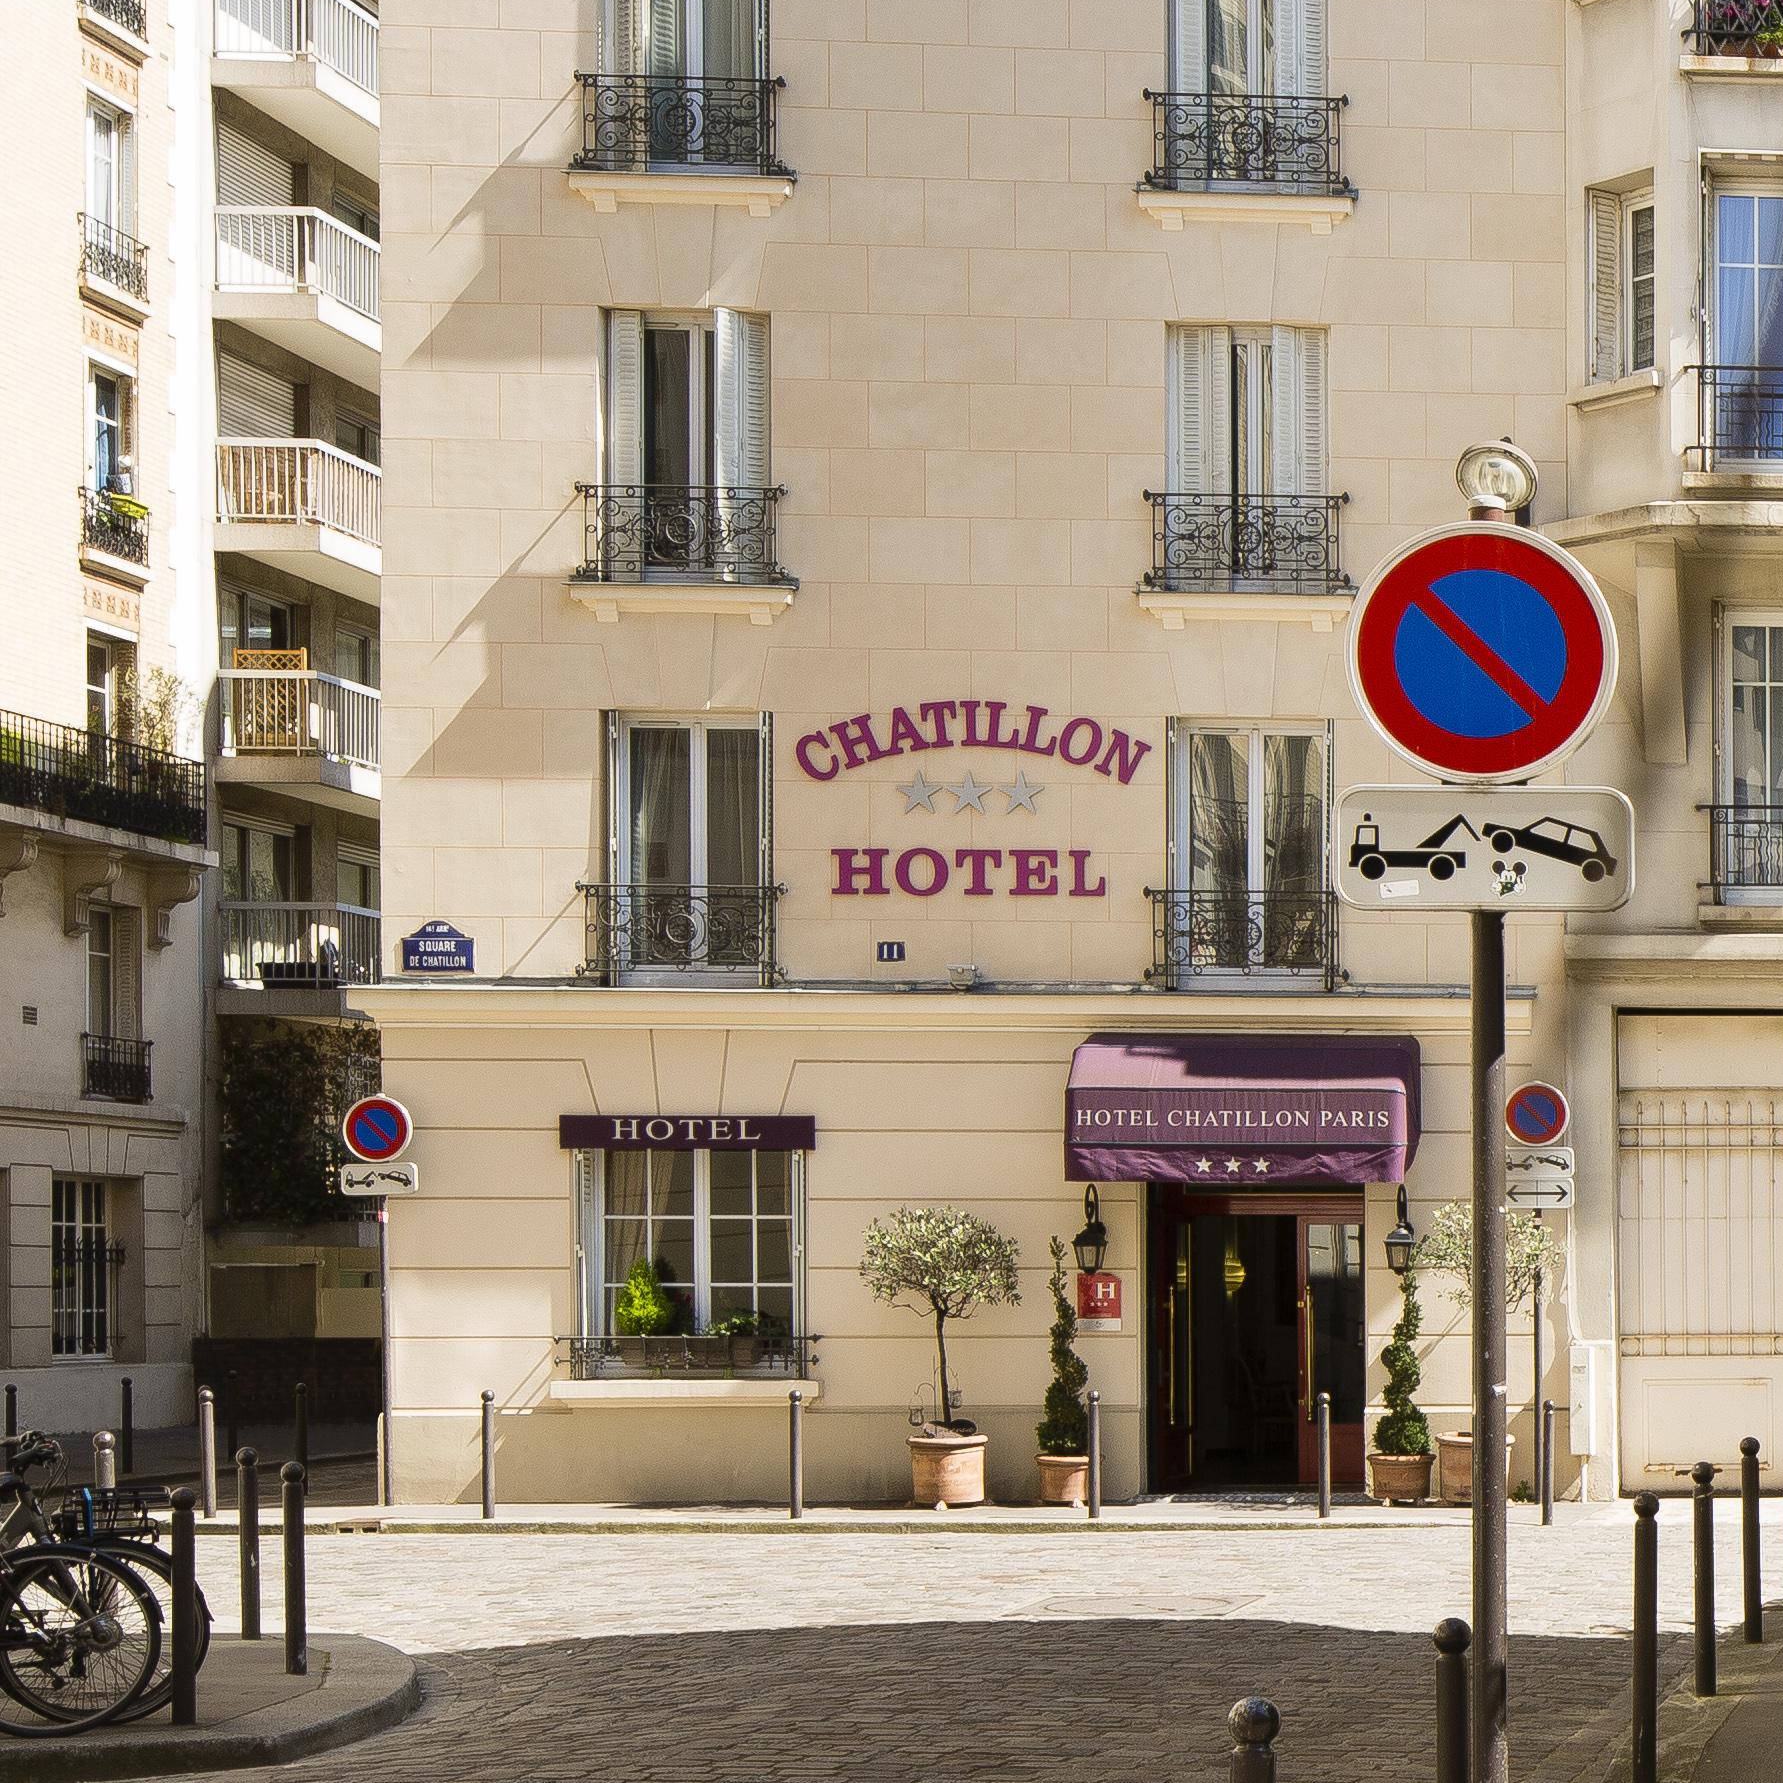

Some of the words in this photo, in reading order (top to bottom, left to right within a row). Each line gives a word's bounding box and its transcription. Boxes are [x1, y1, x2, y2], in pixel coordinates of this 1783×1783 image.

[796, 700, 1152, 785] CHATILLON
[831, 847, 1106, 897] HOTEL
[419, 941, 457, 952] SQUARE
[883, 943, 898, 959] 11
[409, 956, 420, 967] DE
[422, 956, 467, 967] CHATILLON
[1076, 1109, 1159, 1127] HOTEL
[1167, 1109, 1310, 1128] CHATILLON
[1319, 1110, 1389, 1128] PARIS
[612, 1119, 761, 1141] HOTEL
[1096, 1282, 1116, 1299] H
